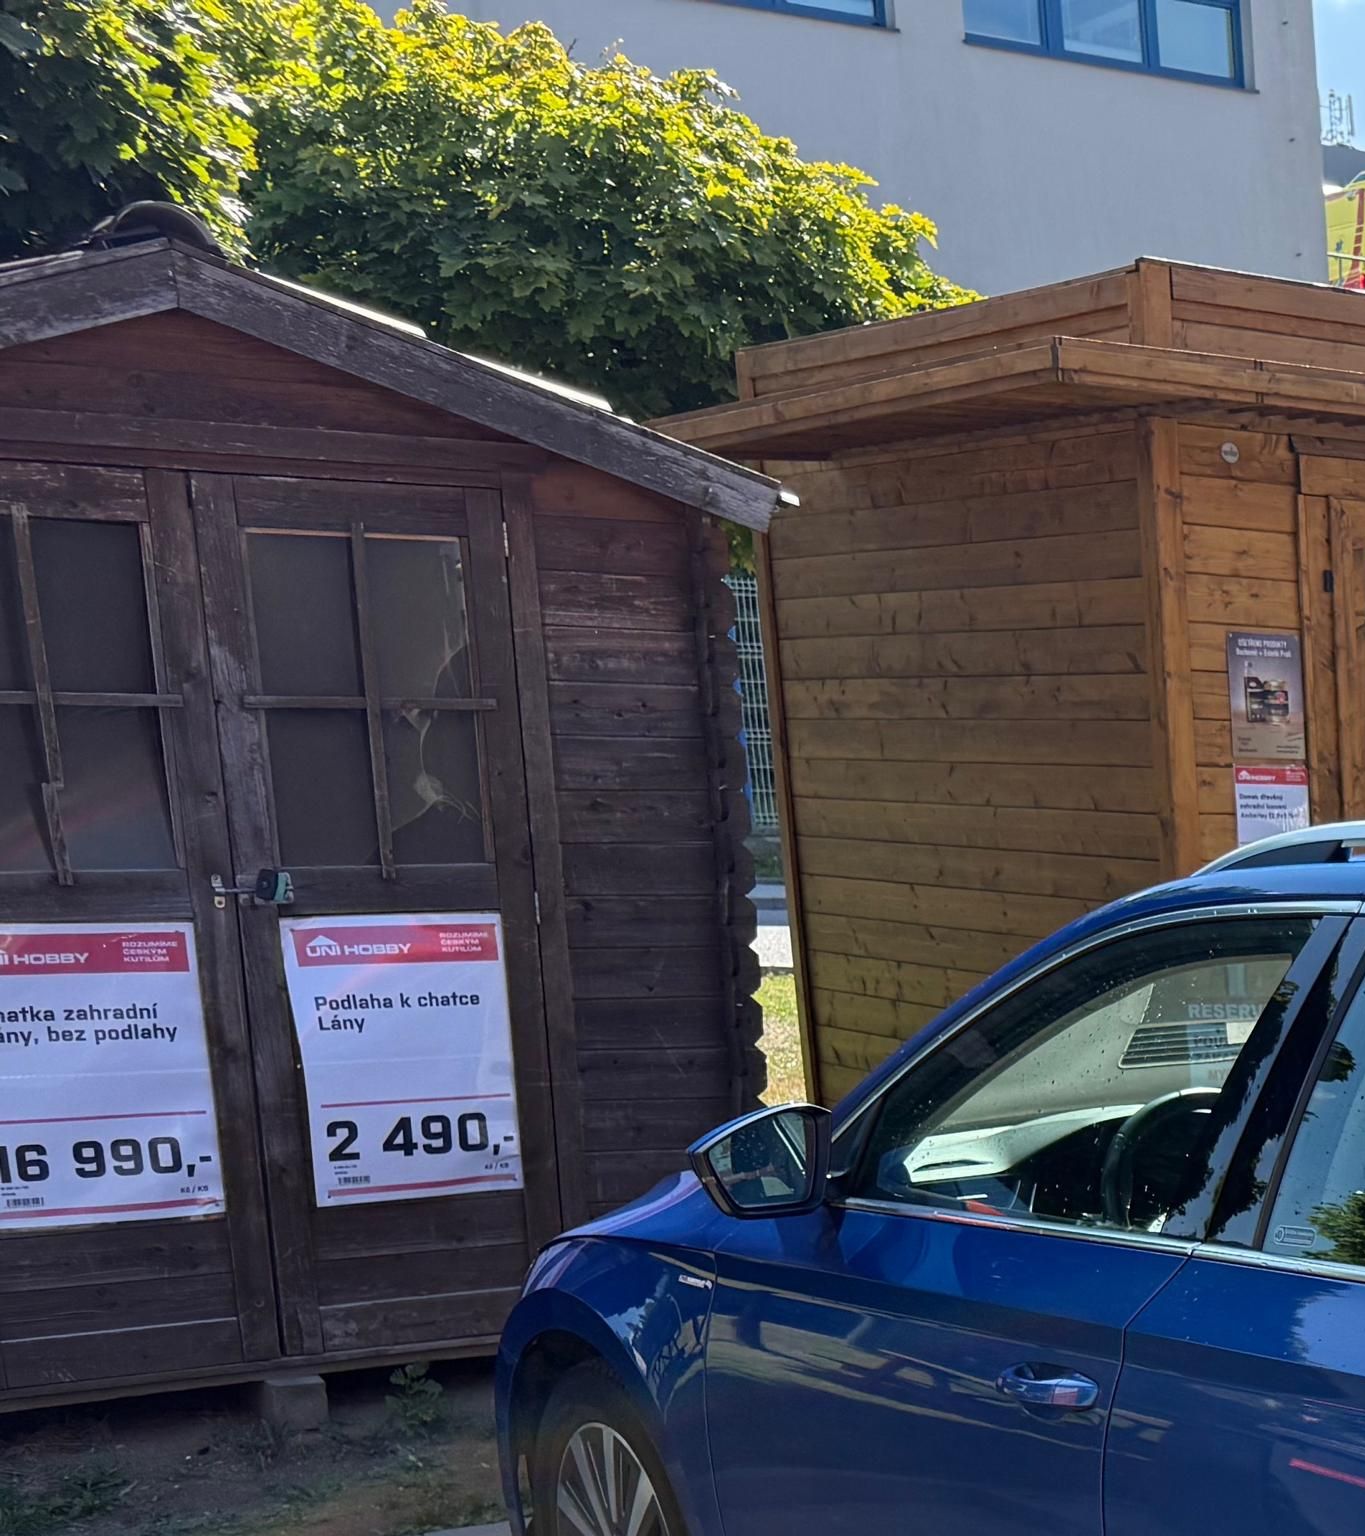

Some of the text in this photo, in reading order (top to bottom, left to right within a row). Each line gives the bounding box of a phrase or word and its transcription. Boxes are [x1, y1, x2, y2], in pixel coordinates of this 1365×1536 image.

[13, 952, 89, 965] HOBBY
[306, 943, 411, 957] UNI HOBBY
[314, 991, 480, 1011] Podlaha k chatce
[63, 1002, 158, 1021] zahradní
[318, 1014, 365, 1033] Lány
[47, 1025, 87, 1042] bez
[94, 1023, 178, 1045] podlahy
[326, 1112, 514, 1162] 2 490,-
[72, 1136, 212, 1179] 990,-
